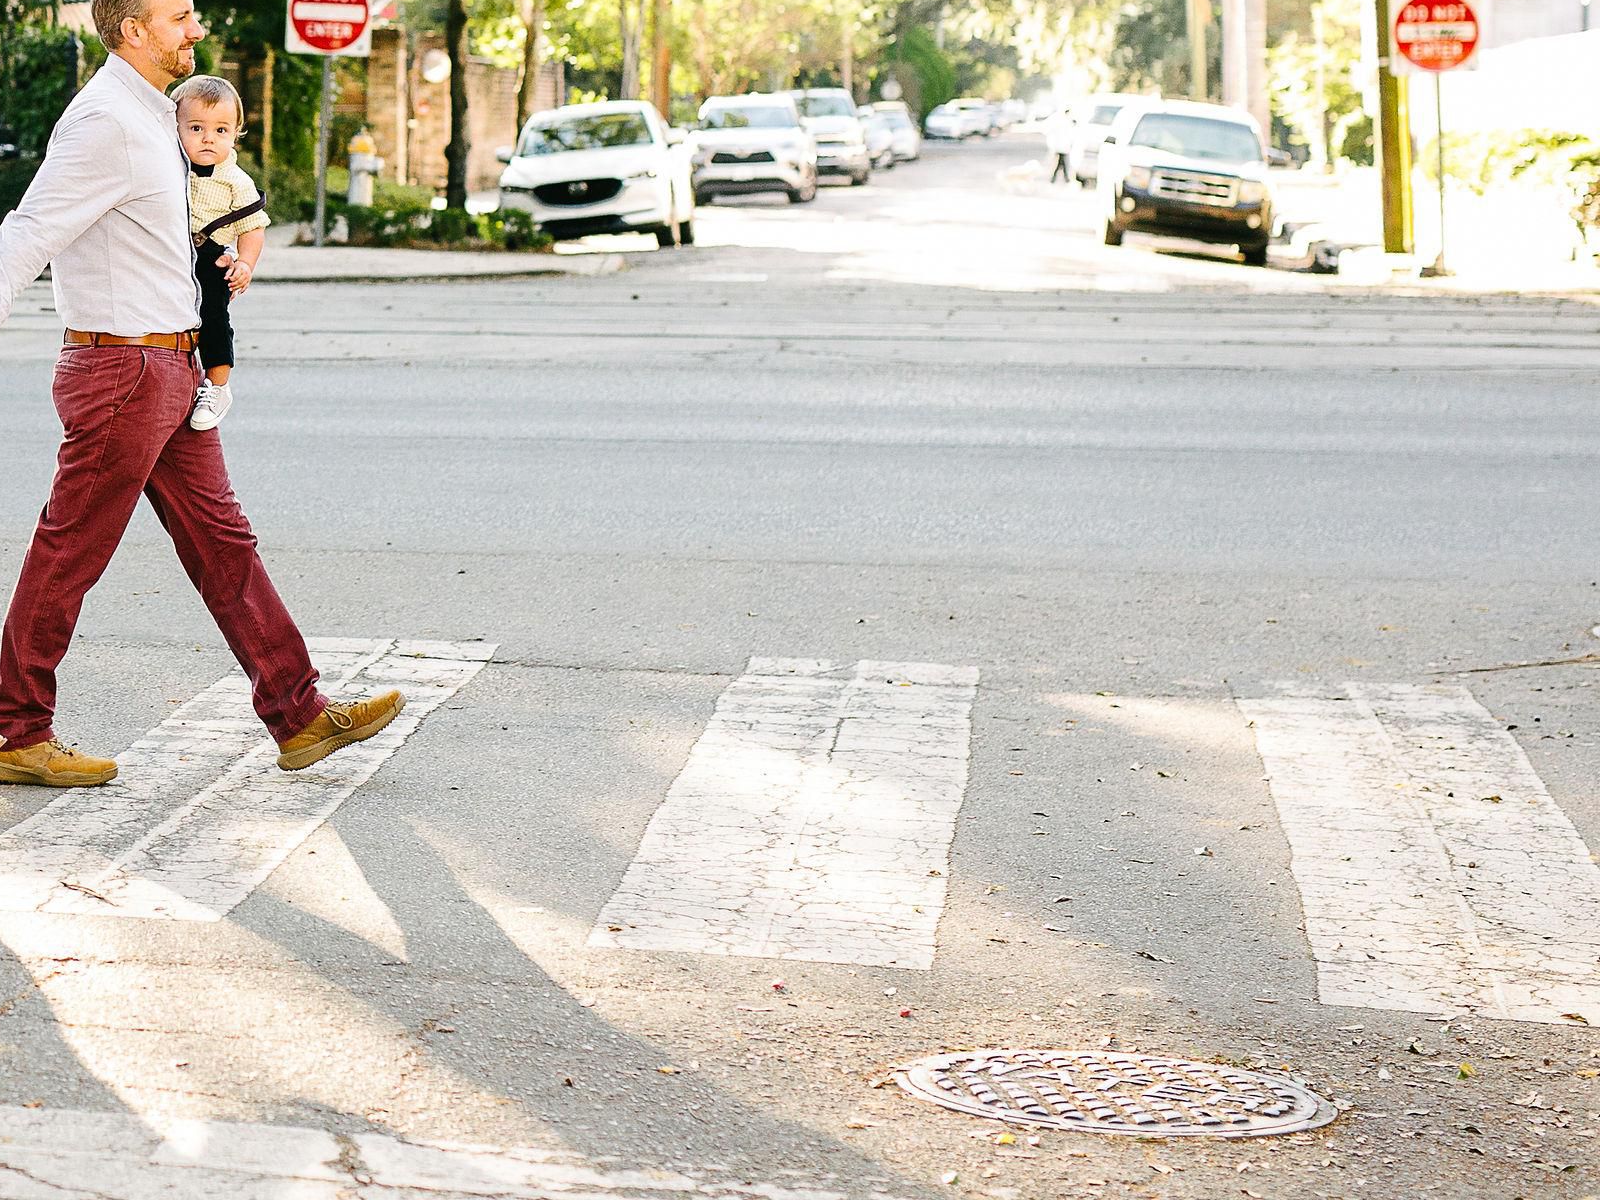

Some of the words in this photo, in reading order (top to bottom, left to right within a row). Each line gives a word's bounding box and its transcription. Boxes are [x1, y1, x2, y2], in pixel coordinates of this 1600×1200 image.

[1403, 4, 1429, 22] DO
[1432, 3, 1466, 22] NOT
[305, 21, 353, 40] ENTER
[1409, 41, 1463, 61] ENTER
